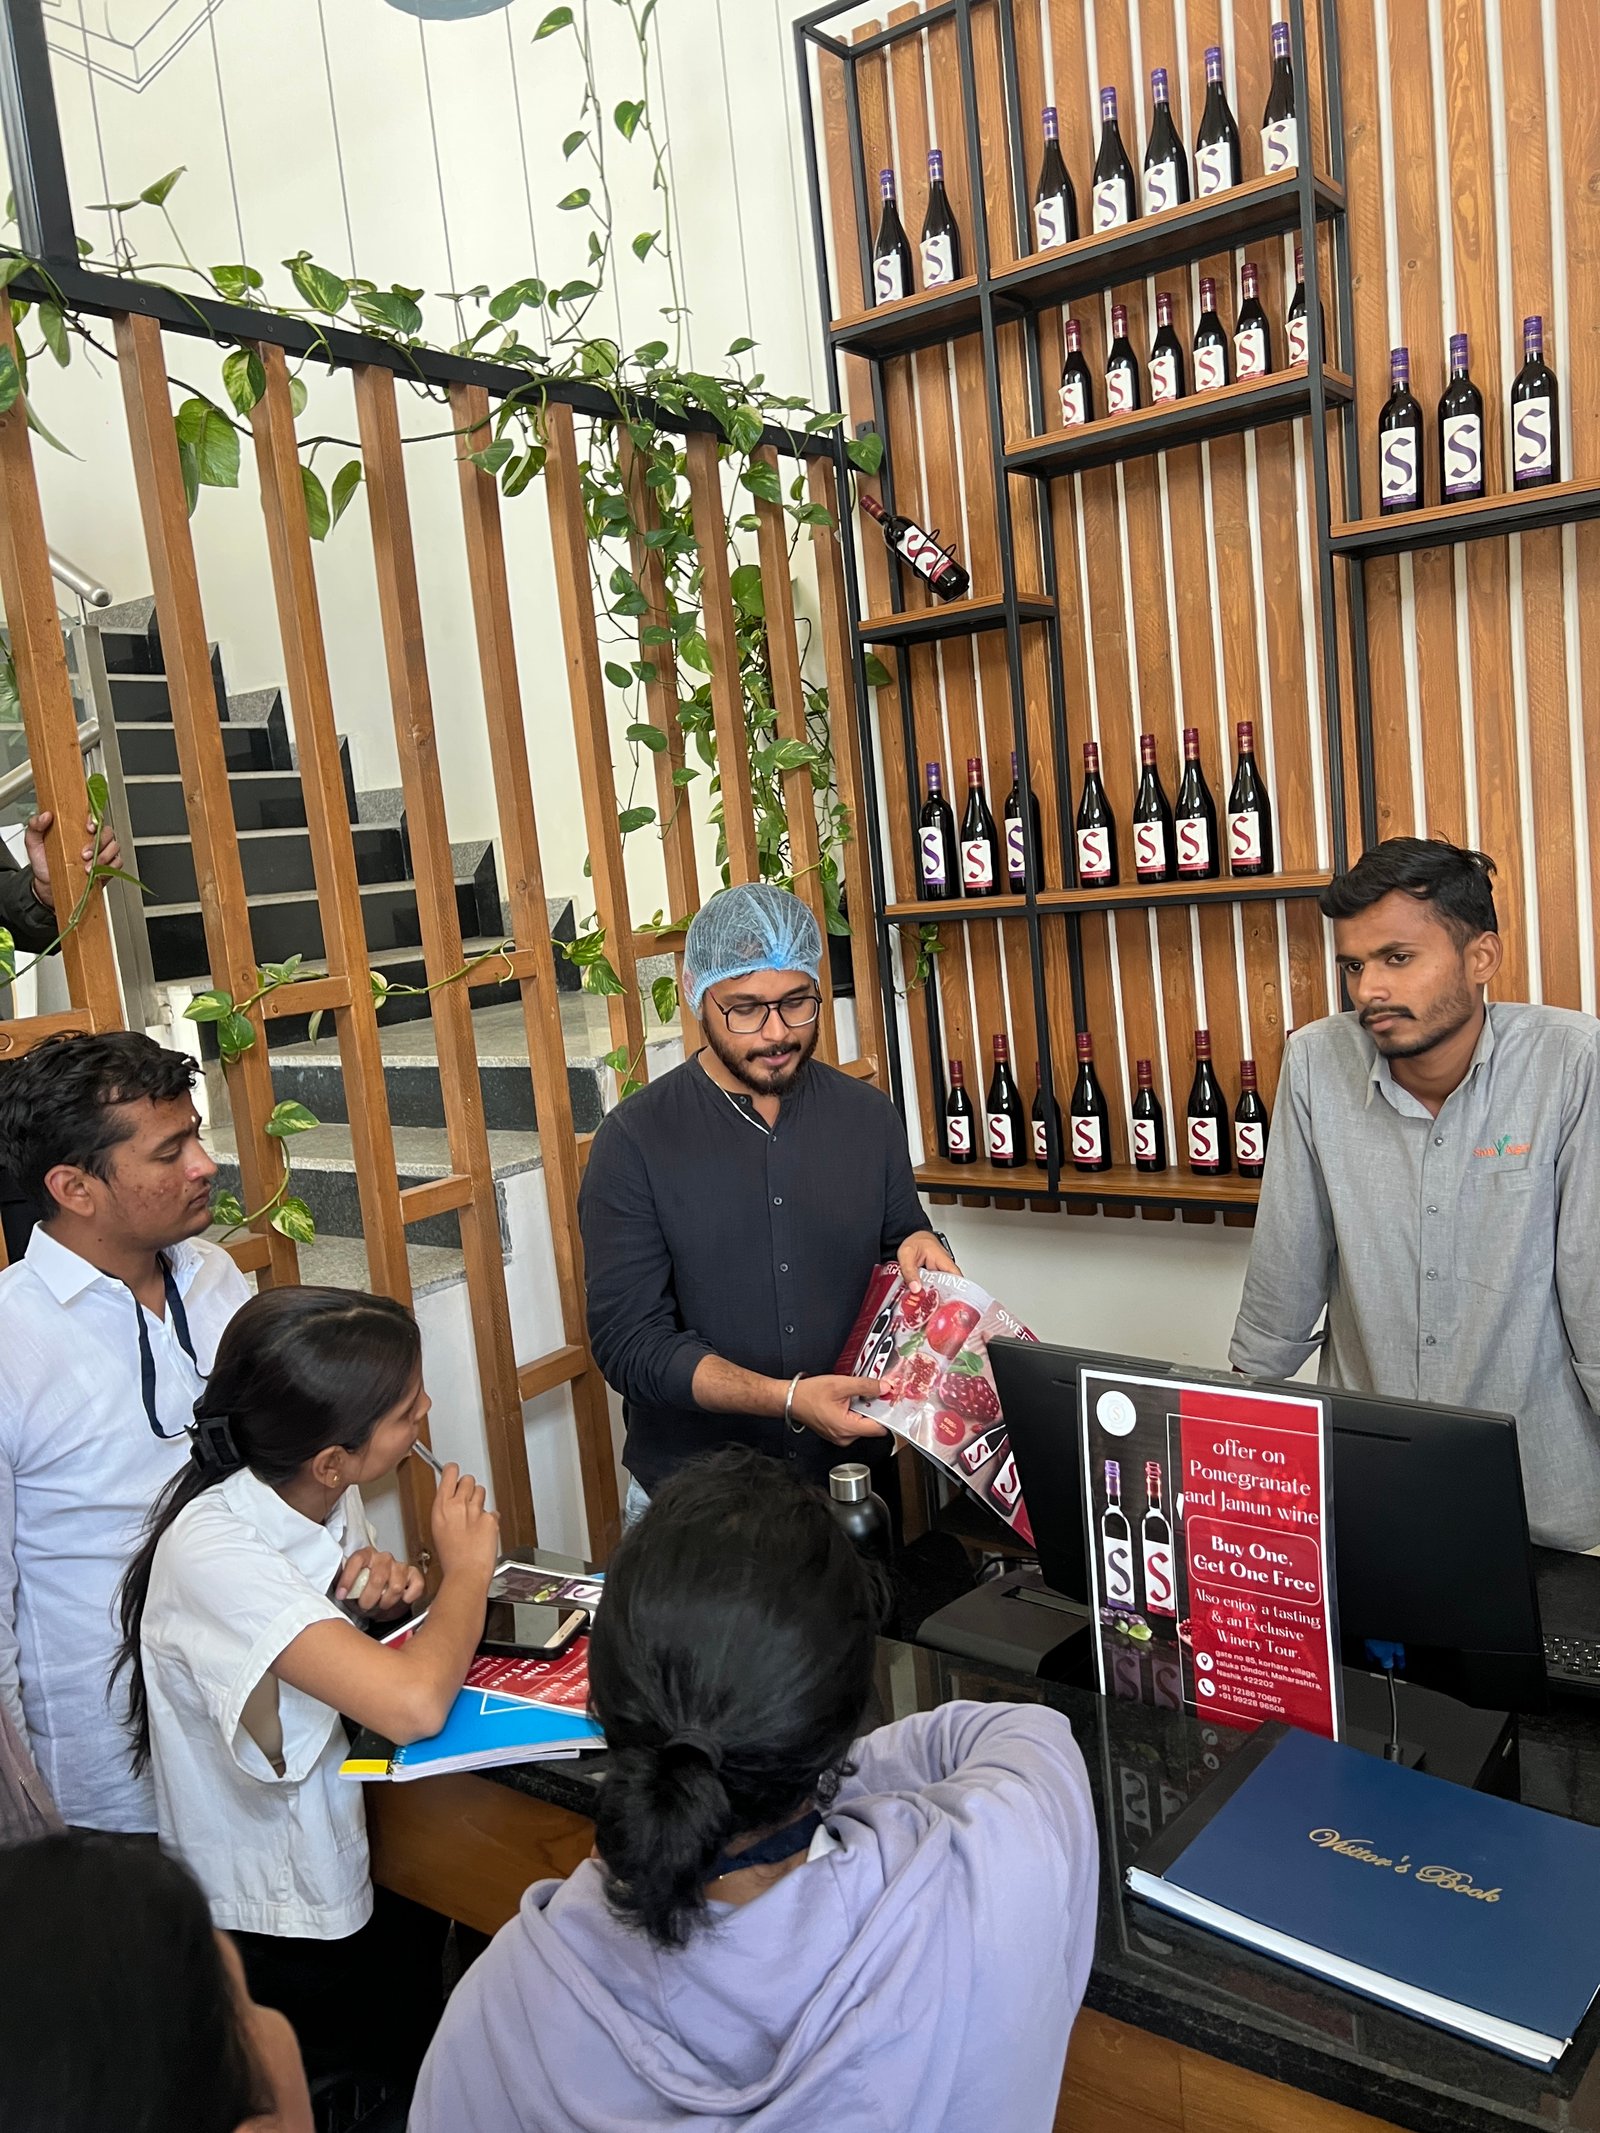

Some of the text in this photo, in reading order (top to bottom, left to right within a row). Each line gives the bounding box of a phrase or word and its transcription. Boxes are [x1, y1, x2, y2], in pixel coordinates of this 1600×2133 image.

[1268, 124, 1289, 171] S
[1201, 148, 1221, 193] S
[1098, 183, 1117, 228] S
[1149, 168, 1167, 212] S
[1038, 202, 1056, 246] S
[925, 239, 943, 280] S
[877, 259, 893, 298] S
[1237, 334, 1256, 371] S
[1289, 322, 1305, 360] S
[1152, 360, 1167, 396] S
[1198, 350, 1216, 386] S
[1062, 388, 1076, 422] S
[1108, 373, 1124, 408] S
[1448, 424, 1477, 478] S
[1517, 408, 1547, 464] S
[1385, 438, 1412, 490] S
[922, 833, 940, 875] S
[1082, 832, 1102, 869] S
[1138, 825, 1156, 864] S
[1180, 822, 1200, 861] S
[1232, 816, 1251, 856] S
[966, 844, 985, 879] S
[949, 1119, 964, 1146] S
[990, 1116, 1006, 1150] S
[1075, 1119, 1094, 1154] S
[1134, 1122, 1148, 1152] S
[1192, 1120, 1211, 1156] S
[1239, 1126, 1256, 1157] S
[968, 1443, 988, 1463] S
[1212, 1438, 1285, 1464] offer on
[1190, 1459, 1311, 1497] Pomegranate
[1184, 1489, 1319, 1526] and Jamun wine
[1211, 1535, 1293, 1567] Buy One,
[1108, 1548, 1130, 1596] S
[1147, 1552, 1172, 1603] S
[1194, 1554, 1316, 1593] Get One Free
[1194, 1588, 1322, 1630] Also enjoy a tasting
[1211, 1610, 1304, 1642] & an Exclusive
[1216, 1628, 1302, 1659] Winery Tour.
[1215, 1650, 1233, 1660] gate
[1234, 1654, 1244, 1662] no
[1290, 1666, 1318, 1680] village,
[1216, 1659, 1240, 1672] taluka
[1271, 1672, 1322, 1691] Maharashtra,
[1216, 1669, 1274, 1689] Nashik 422202
[1308, 1828, 1503, 1904] Visitor's Book
